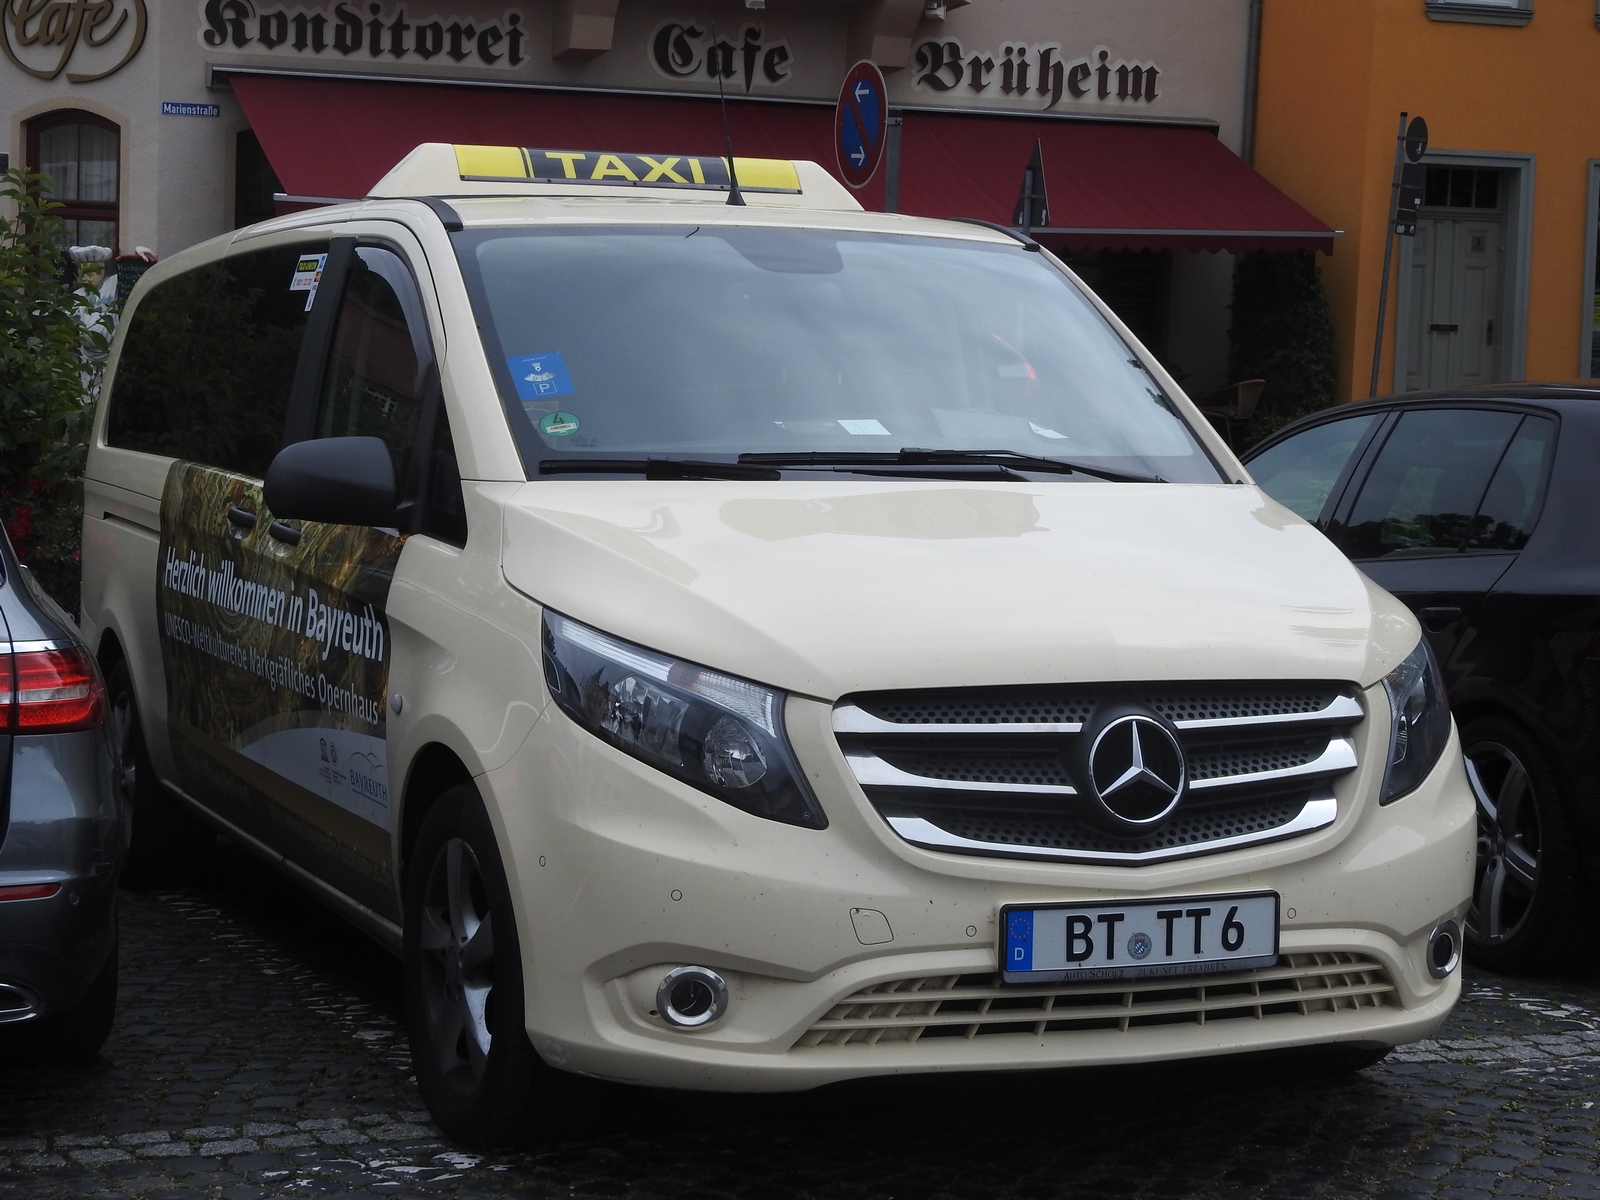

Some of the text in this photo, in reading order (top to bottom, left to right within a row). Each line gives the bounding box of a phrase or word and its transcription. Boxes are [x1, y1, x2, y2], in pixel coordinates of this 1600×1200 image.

[203, 0, 1160, 111] Konditorei Cafe Brüheim
[163, 103, 218, 116] Marienstraße
[544, 151, 706, 185] TAXI
[1475, 237, 1481, 247] 3
[539, 383, 550, 393] P
[553, 413, 565, 424] 4
[165, 546, 384, 662] Herzlich willkommen in Bayreuth
[164, 611, 248, 670] UNESCO-Weltkulturerbe
[318, 672, 379, 726] Opernhaus
[1066, 913, 1125, 962] BT
[1221, 905, 1245, 952] 6
[1014, 947, 1025, 961] D
[1063, 963, 1227, 981] AUTO SCHOLZ ZUKUNFT ERFAHREN
